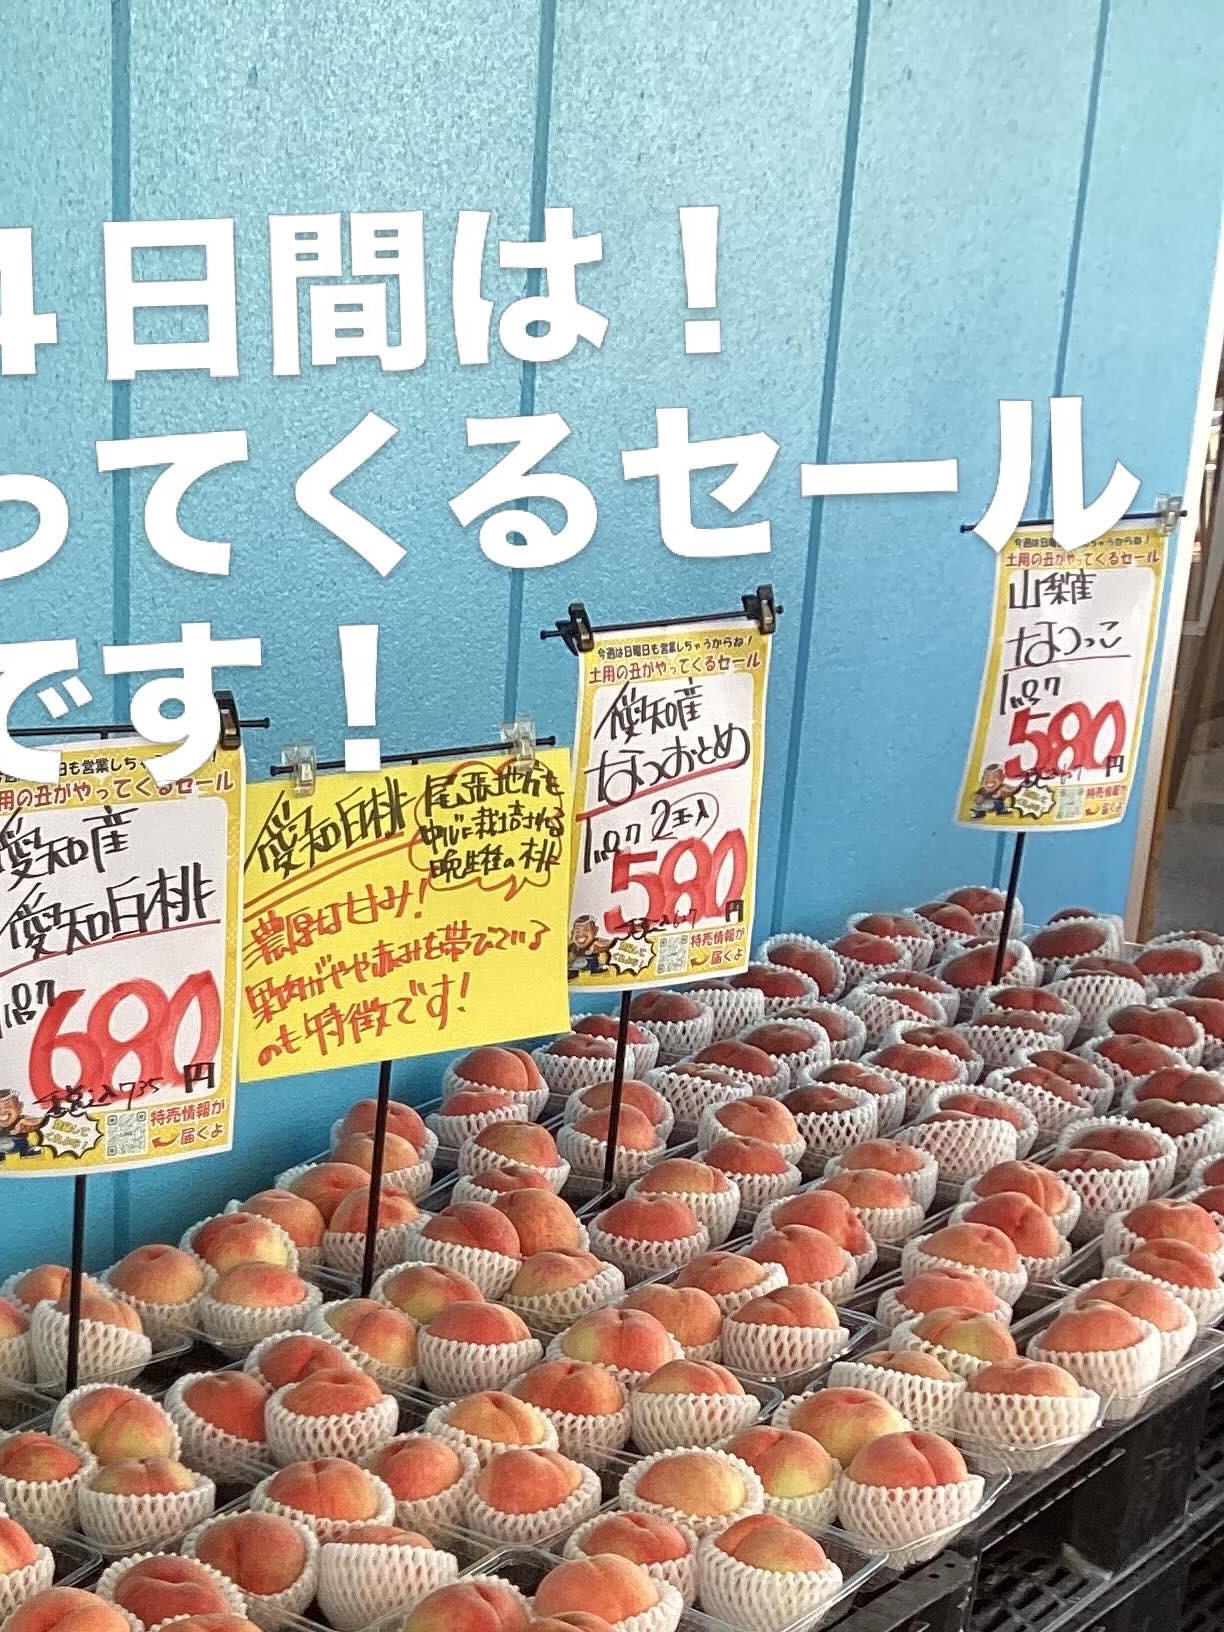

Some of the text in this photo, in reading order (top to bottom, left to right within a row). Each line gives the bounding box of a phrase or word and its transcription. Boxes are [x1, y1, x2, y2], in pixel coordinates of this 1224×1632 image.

[1005, 551, 1160, 568] 土用の丑がやってくるセール
[1009, 568, 1097, 609] 山梨産
[1006, 621, 1122, 667] なつっこ
[588, 652, 761, 684] 土用の丑がやってくるセール
[593, 677, 704, 744] 愛知産
[584, 723, 751, 806] なつおとめ
[710, 948, 744, 966] 届くよ
[257, 972, 472, 1067] のも特徴です！
[150, 1099, 225, 1127] 特売情報が
[180, 1126, 224, 1146] 届くよ
